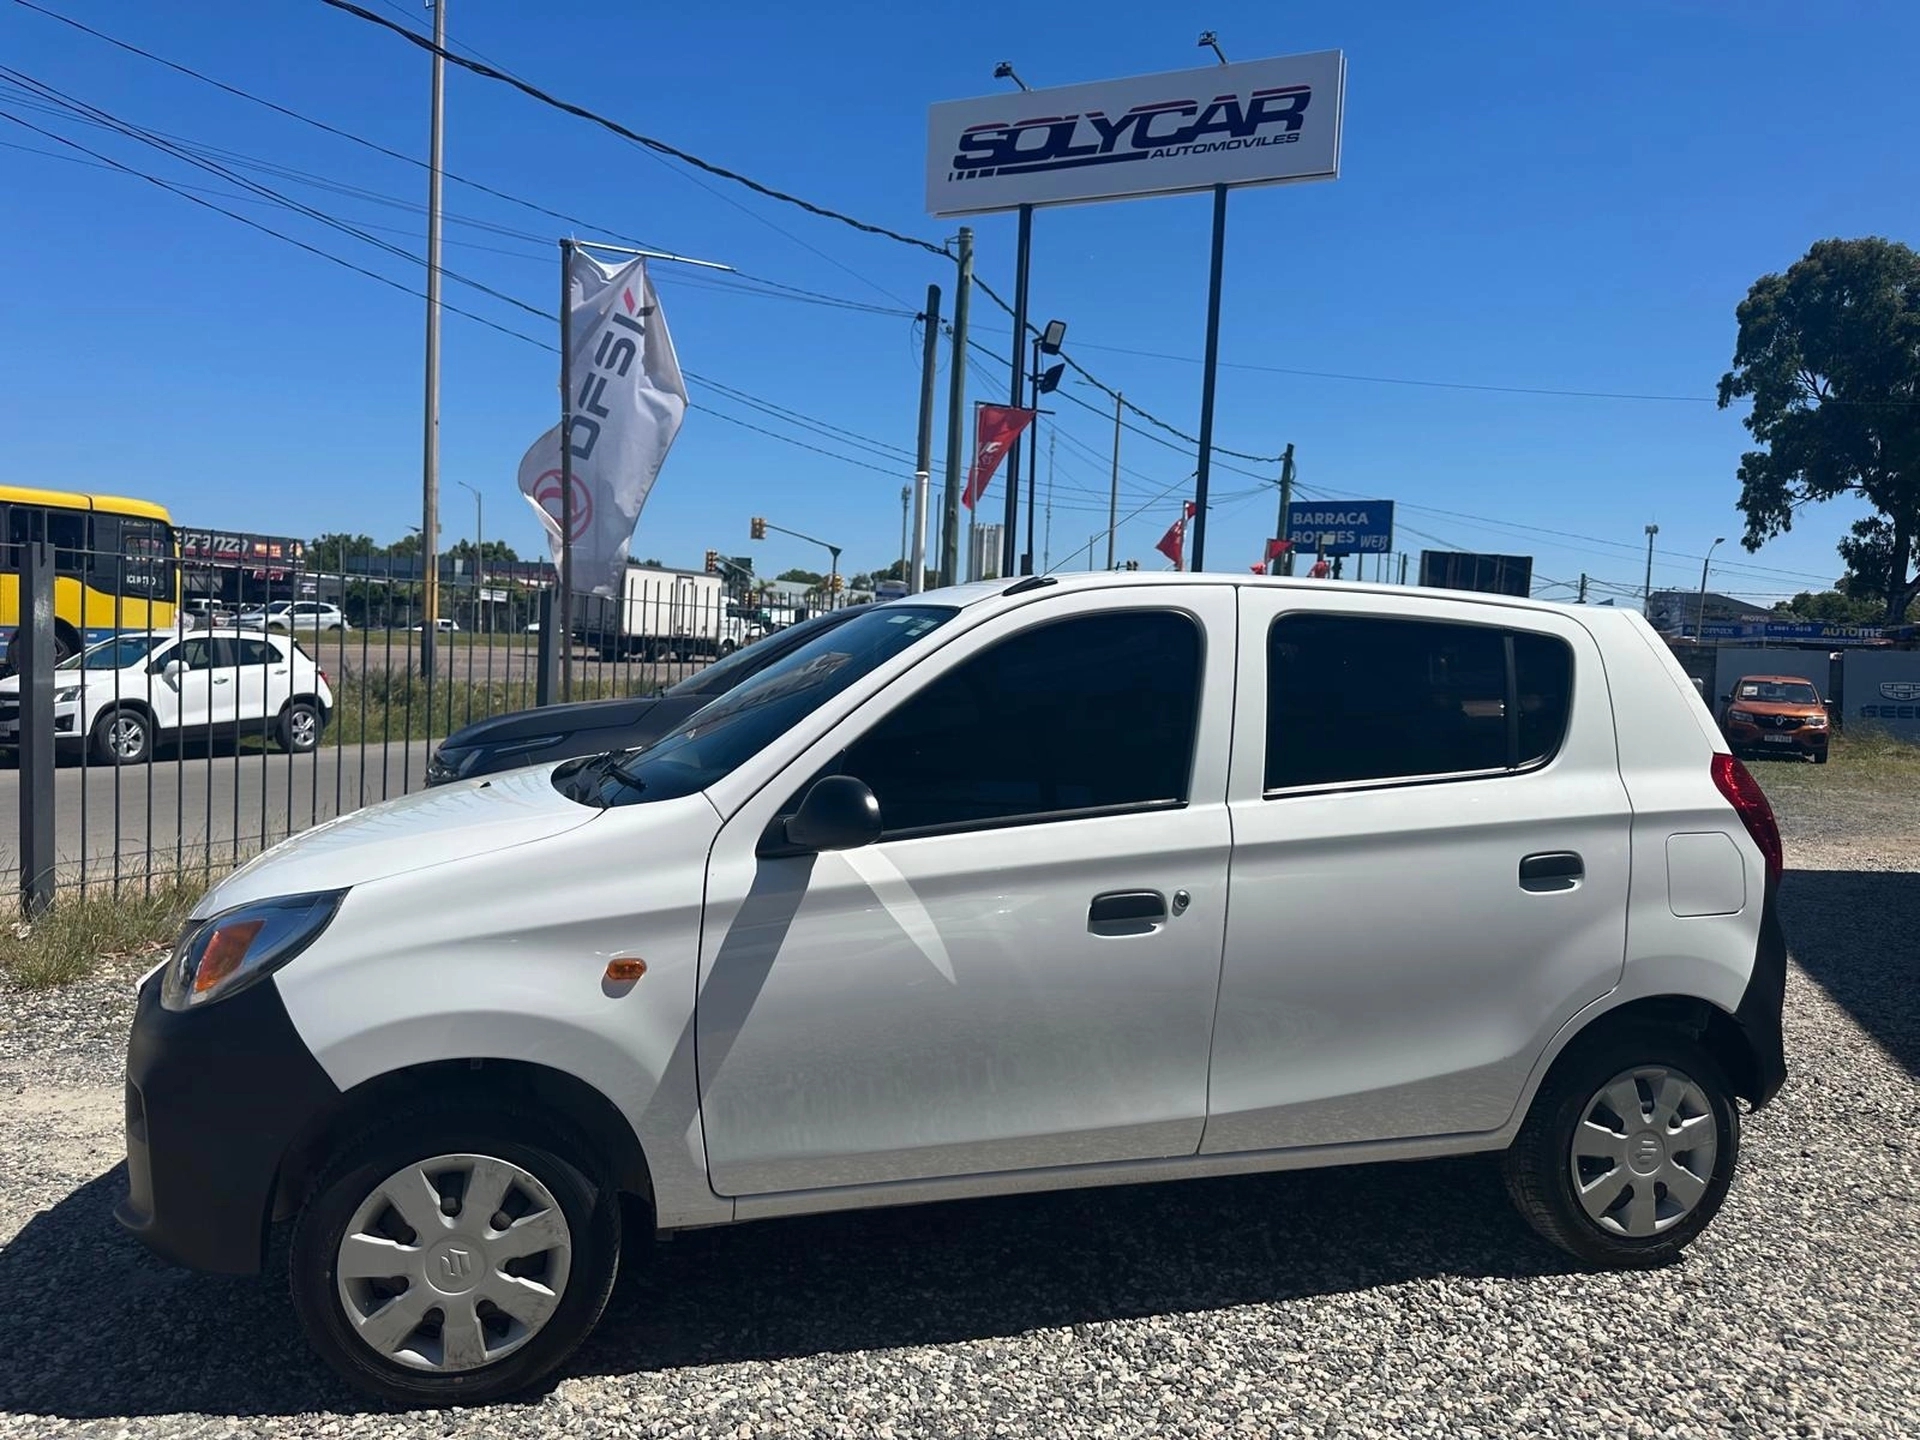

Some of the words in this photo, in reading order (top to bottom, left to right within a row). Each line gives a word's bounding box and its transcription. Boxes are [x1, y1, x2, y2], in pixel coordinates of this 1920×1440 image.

[953, 84, 1311, 170] SOLYCAR
[1149, 132, 1300, 160] AUTOMOVILES
[1292, 512, 1369, 525] BARRACA
[1292, 530, 1356, 544] BORES
